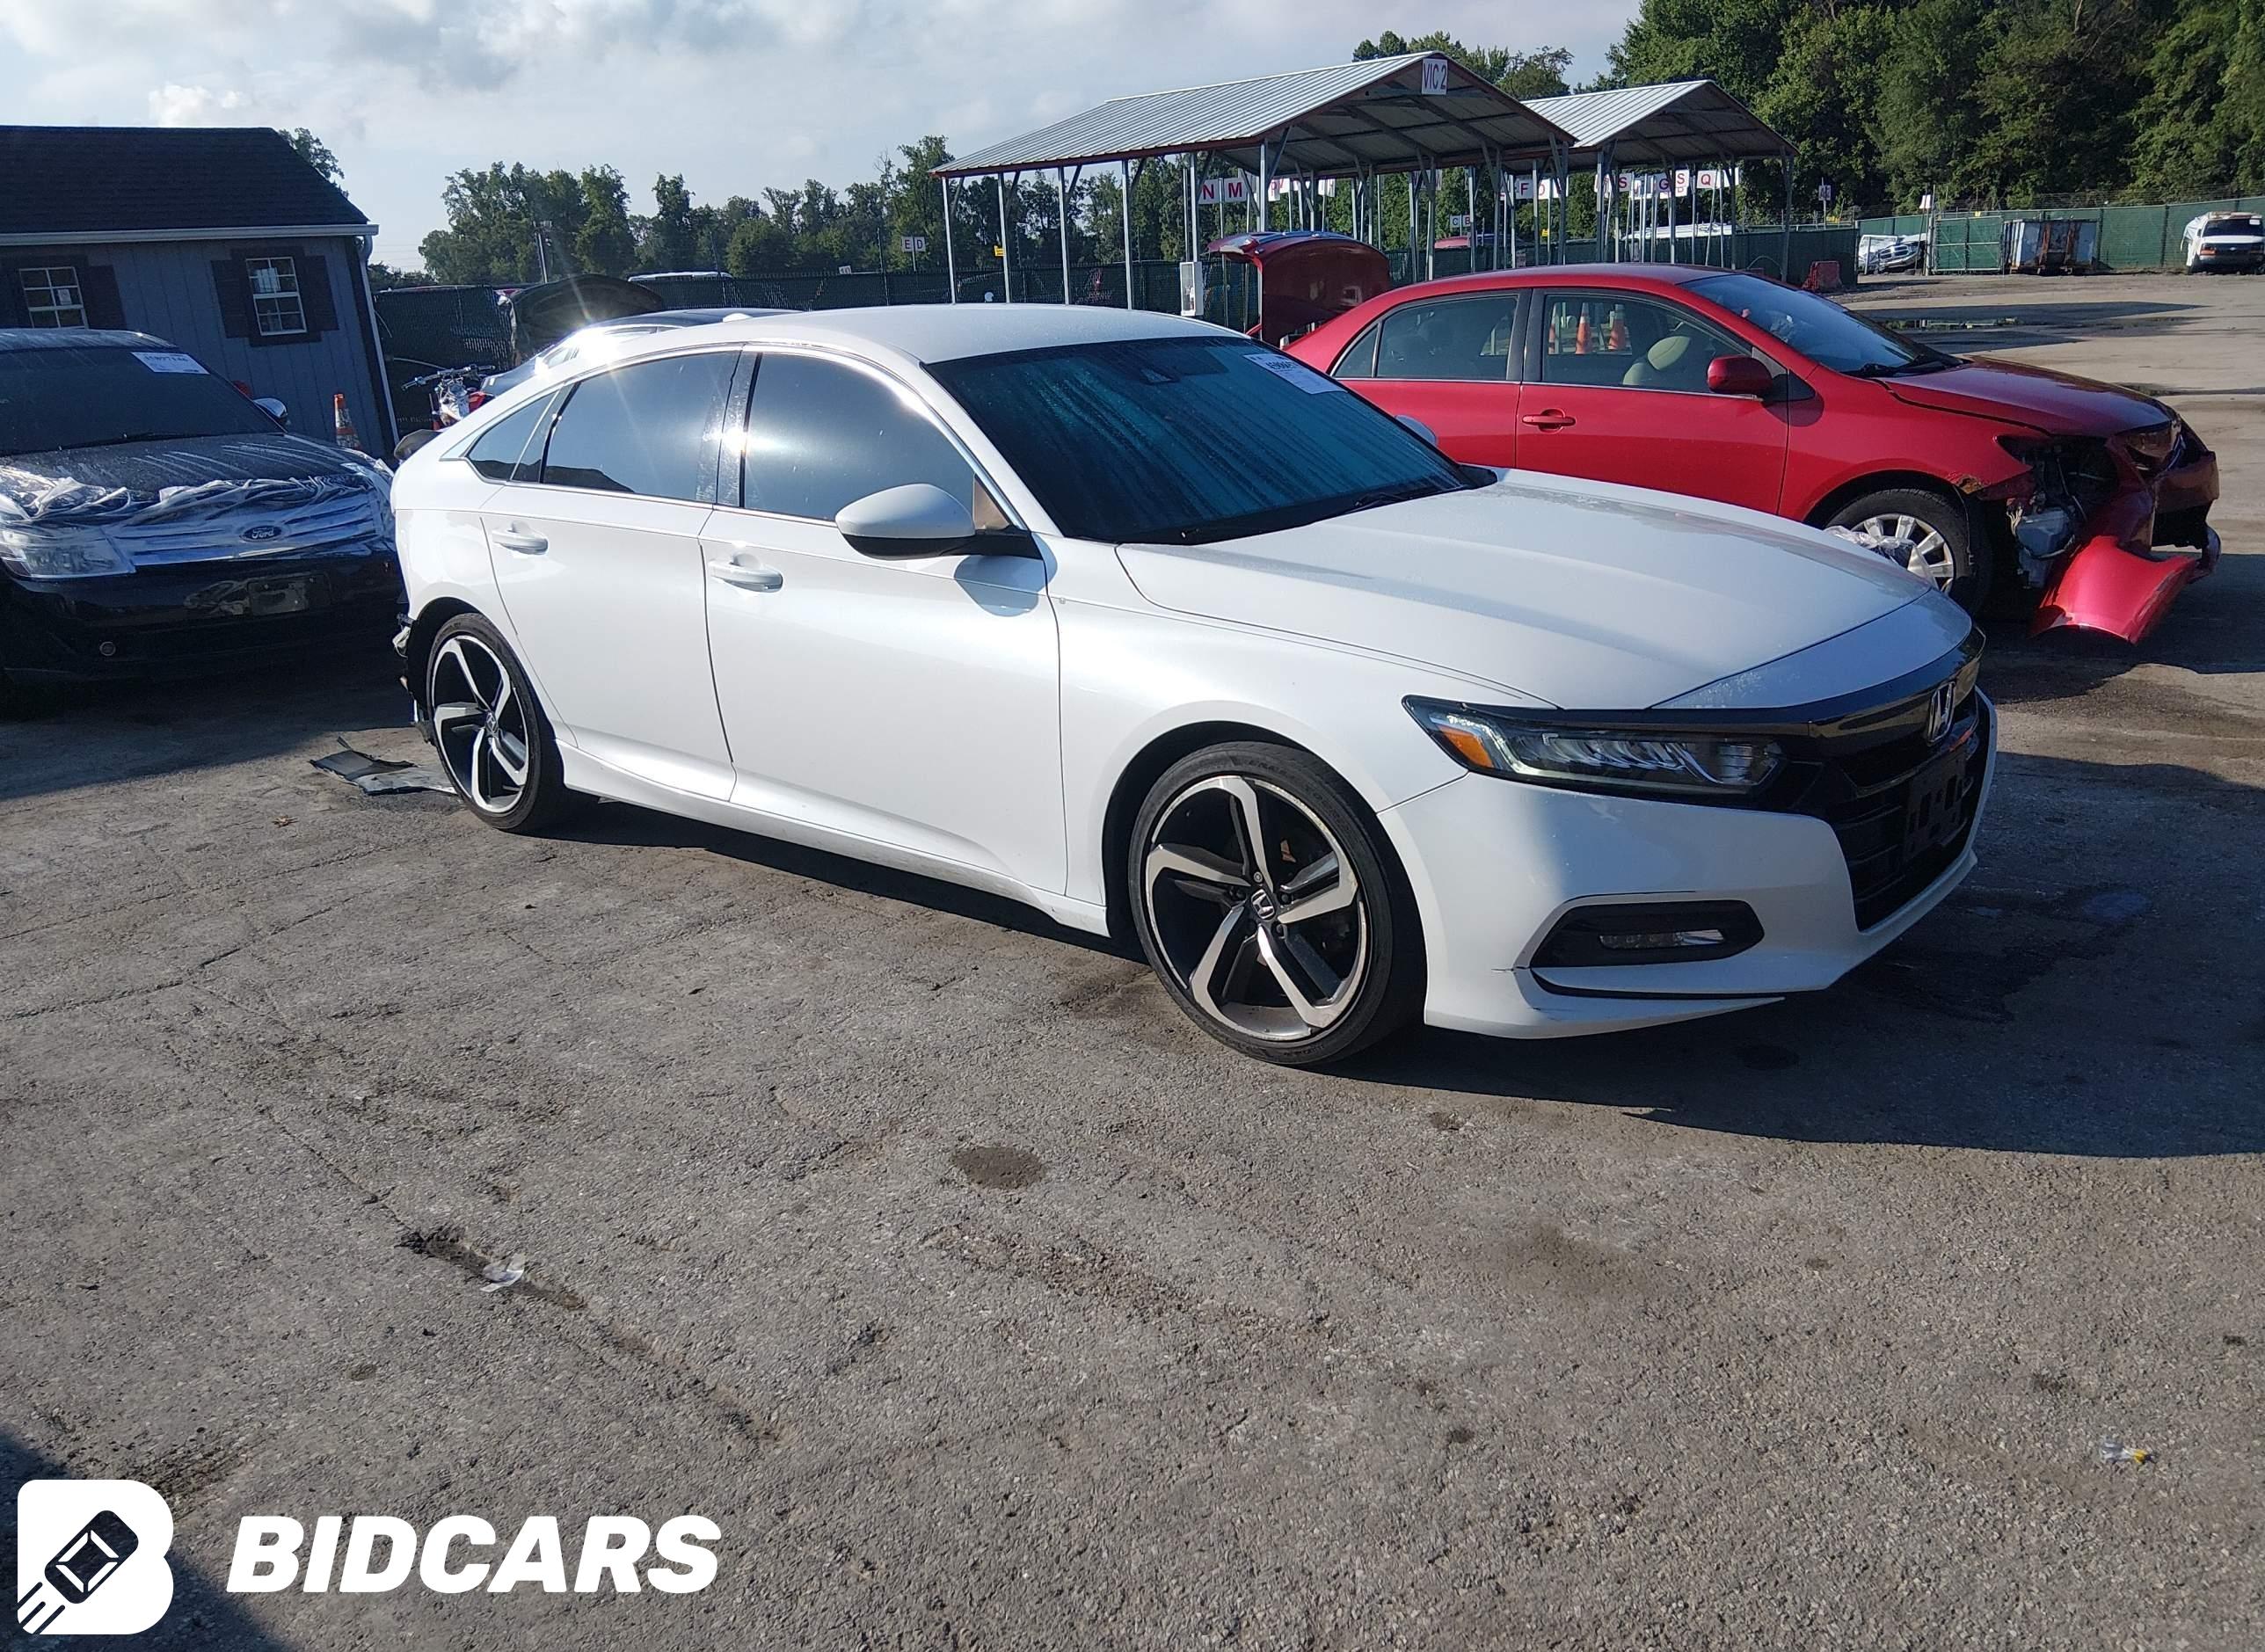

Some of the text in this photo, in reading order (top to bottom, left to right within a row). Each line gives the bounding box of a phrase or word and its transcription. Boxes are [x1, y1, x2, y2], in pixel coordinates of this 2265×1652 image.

[1423, 62, 1447, 90] VIC 2
[1618, 176, 1628, 189] S
[1658, 178, 1670, 191] G
[1677, 172, 1686, 185] S
[1701, 173, 1711, 186] Q
[1202, 183, 1215, 200] N
[1227, 181, 1242, 198] M
[1520, 182, 1530, 196] F
[904, 239, 911, 250] E
[916, 239, 923, 250] D
[251, 528, 275, 539] Ford
